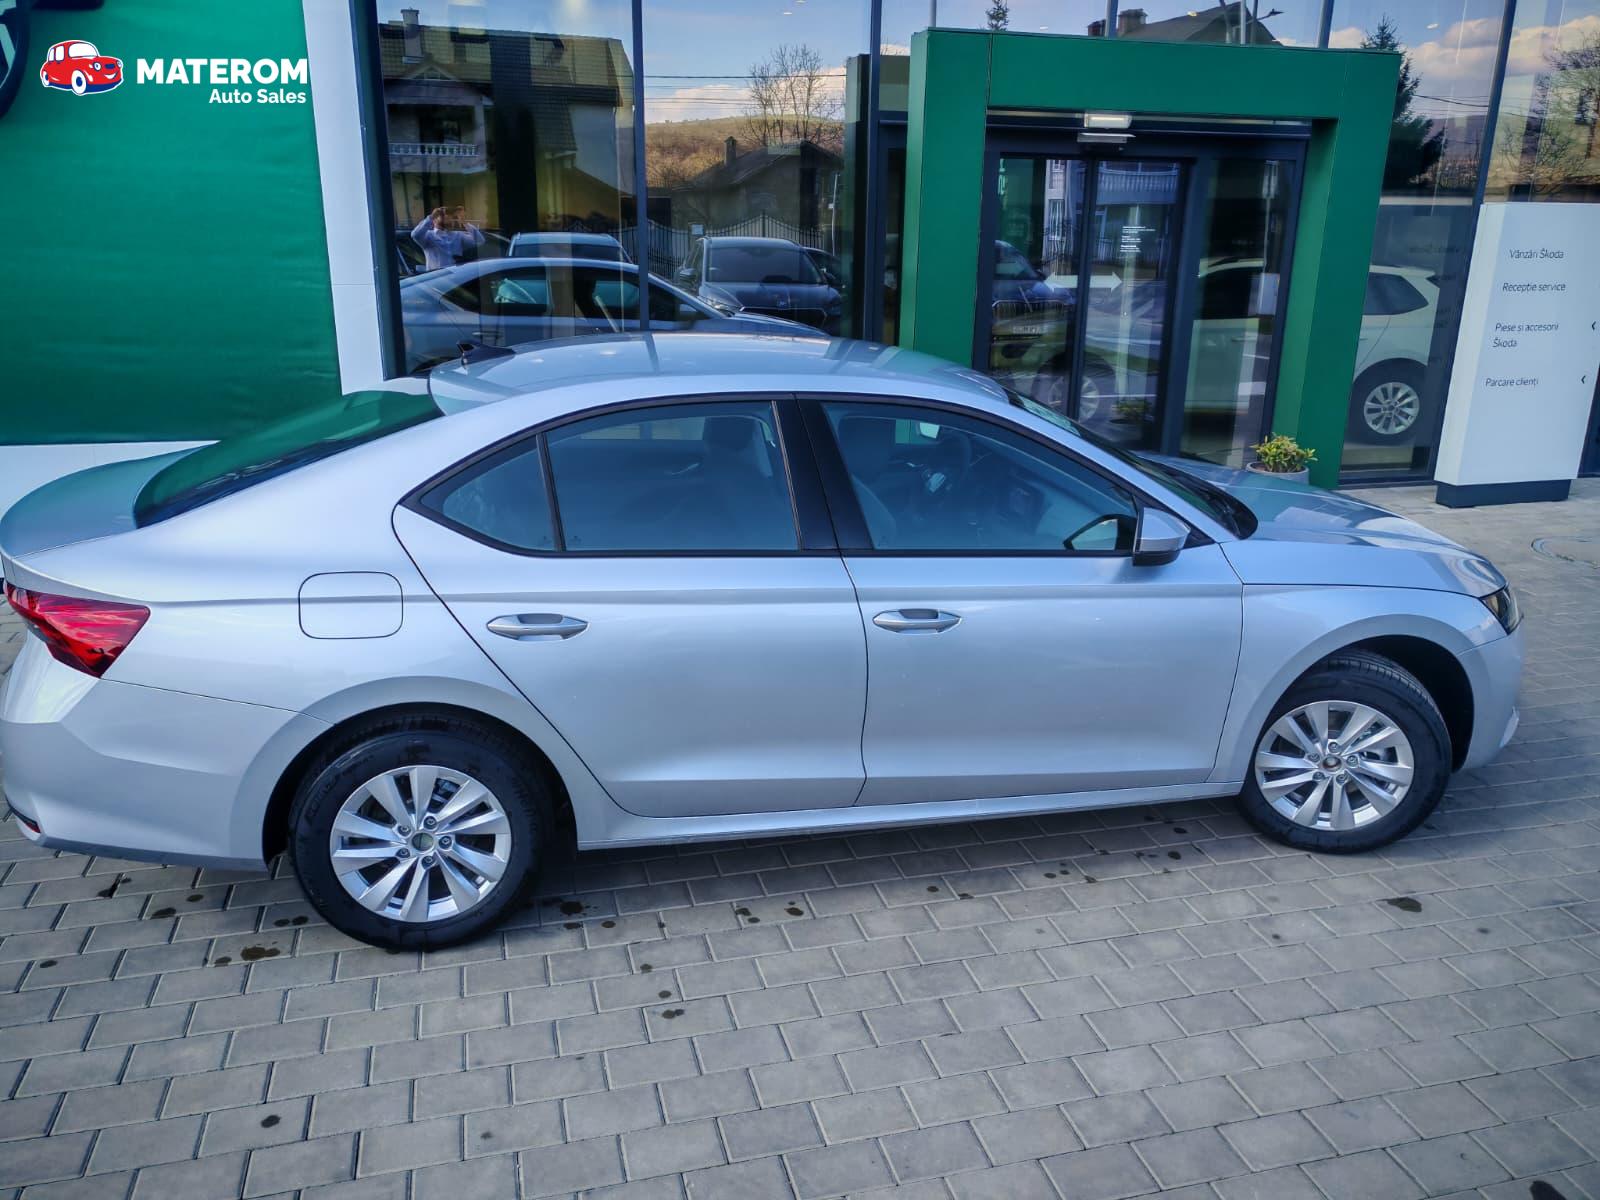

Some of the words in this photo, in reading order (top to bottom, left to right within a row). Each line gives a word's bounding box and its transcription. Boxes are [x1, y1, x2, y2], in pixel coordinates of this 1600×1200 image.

[1539, 247, 1564, 259] Škoda
[1538, 282, 1566, 291] service
[1495, 322, 1516, 332] Piese
[1492, 336, 1517, 348] Škoda
[1485, 377, 1515, 387] Parcare
